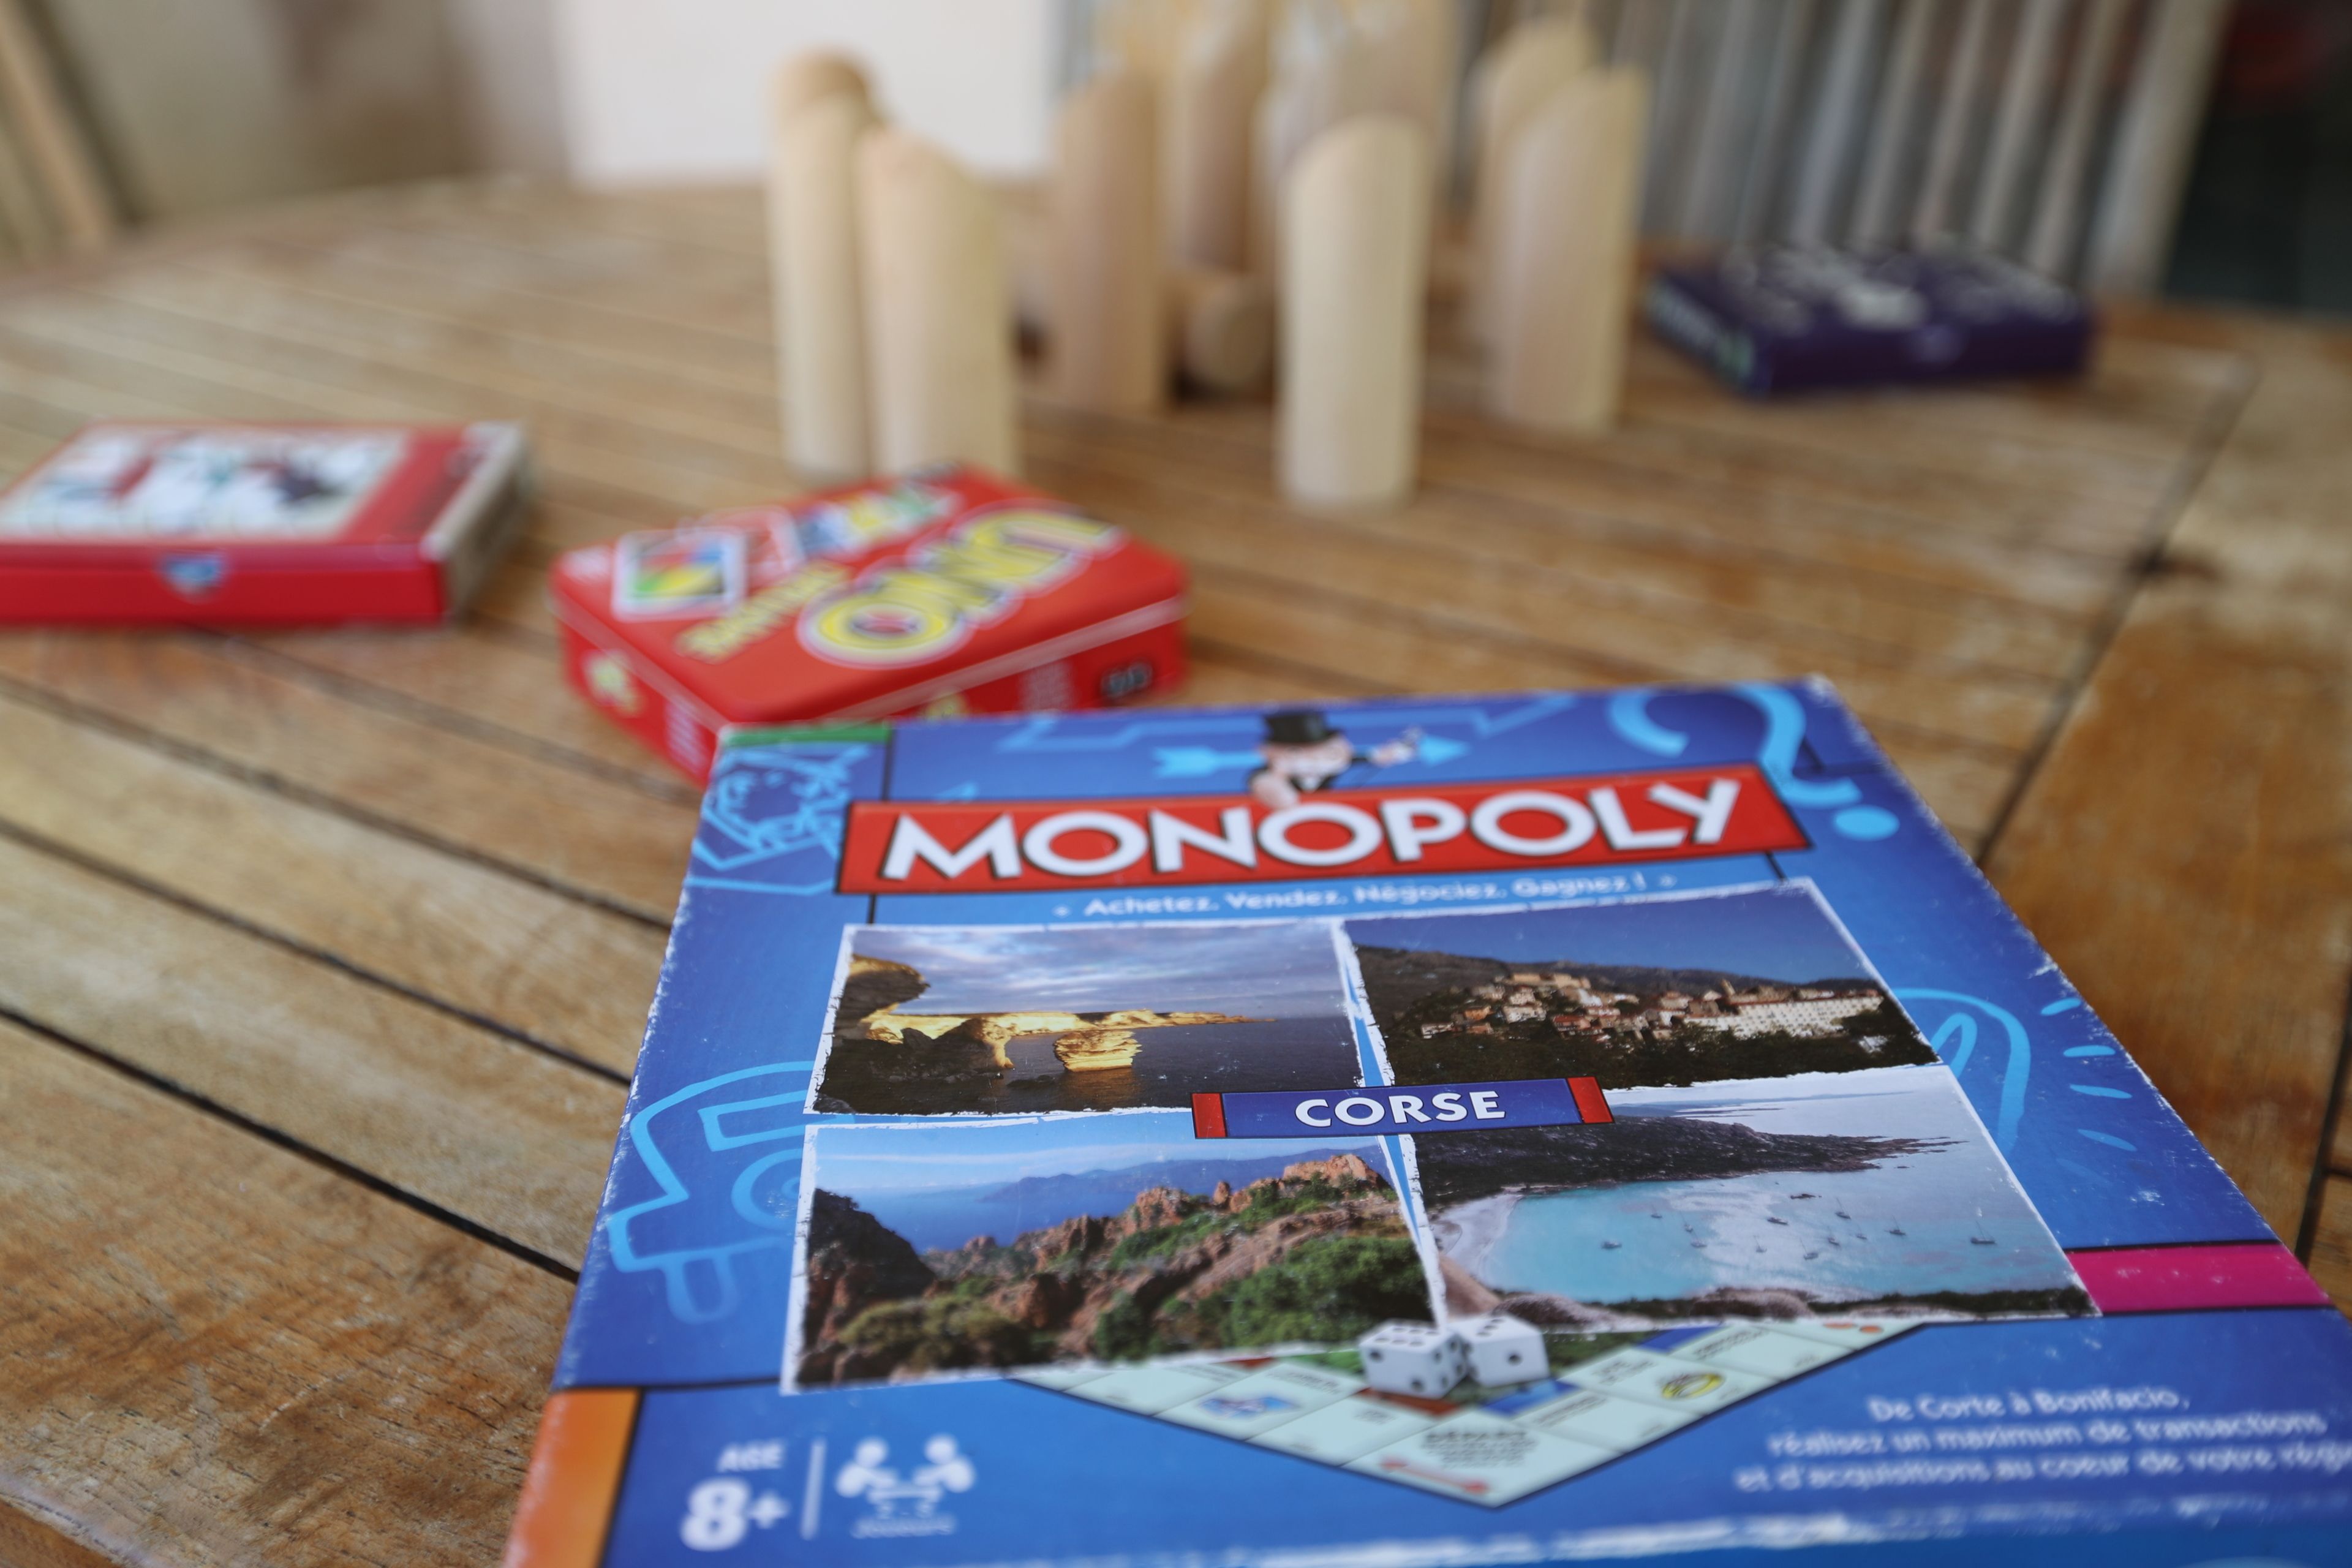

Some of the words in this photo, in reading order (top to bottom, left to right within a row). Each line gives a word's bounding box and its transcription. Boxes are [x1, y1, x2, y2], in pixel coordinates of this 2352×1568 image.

[878, 777, 1741, 880] MONOPOLY
[1295, 1090, 1506, 1128] CORSE
[1868, 1396, 1914, 1422] De
[1918, 1392, 2005, 1419] Corte
[718, 1441, 785, 1472] AGE
[1768, 1431, 1888, 1457] réalisez
[1891, 1428, 1931, 1452] un
[1934, 1424, 2082, 1450] maximum
[2089, 1419, 2132, 1444] de
[2135, 1411, 2328, 1440] transactions
[1735, 1466, 1773, 1492] et
[1995, 1458, 2033, 1480] au
[2139, 1449, 2184, 1474] de
[2187, 1446, 2277, 1471] votre
[681, 1477, 790, 1551] 8+
